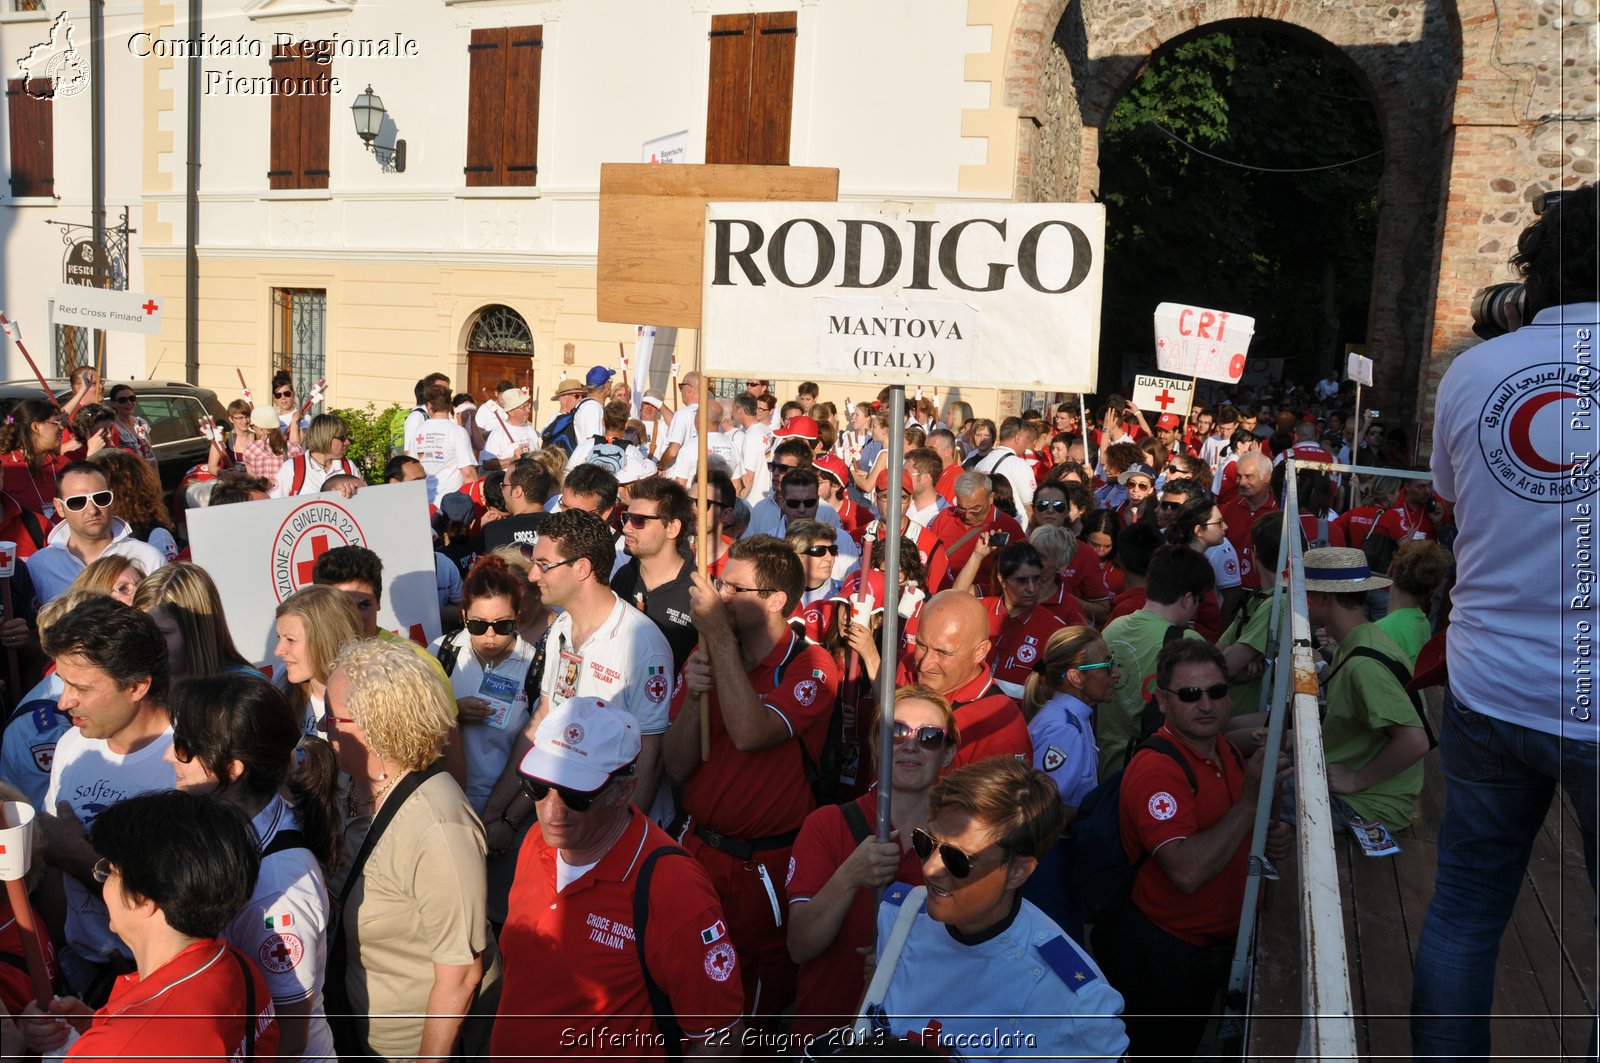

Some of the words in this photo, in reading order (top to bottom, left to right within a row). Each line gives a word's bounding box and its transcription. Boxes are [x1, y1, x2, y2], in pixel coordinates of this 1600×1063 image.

[709, 218, 1093, 295] RODIGO
[59, 304, 78, 314] Red
[80, 307, 107, 318] Cross
[110, 311, 143, 323] Finland
[828, 315, 964, 342] MANTOVA
[853, 349, 936, 374] (ITALY)
[1137, 376, 1193, 392] GUASTALLA
[1490, 448, 1517, 483] Syrian
[1516, 476, 1546, 497] Arab
[1549, 482, 1574, 497] Red
[281, 529, 296, 547] DI
[292, 507, 339, 533] GINEVRA
[338, 518, 354, 538] 22
[590, 661, 605, 673] CROCE
[606, 667, 621, 680] ROSSA
[593, 670, 613, 685] ITALIANA
[586, 912, 611, 931] CROCE
[589, 928, 625, 950] ITALIANA
